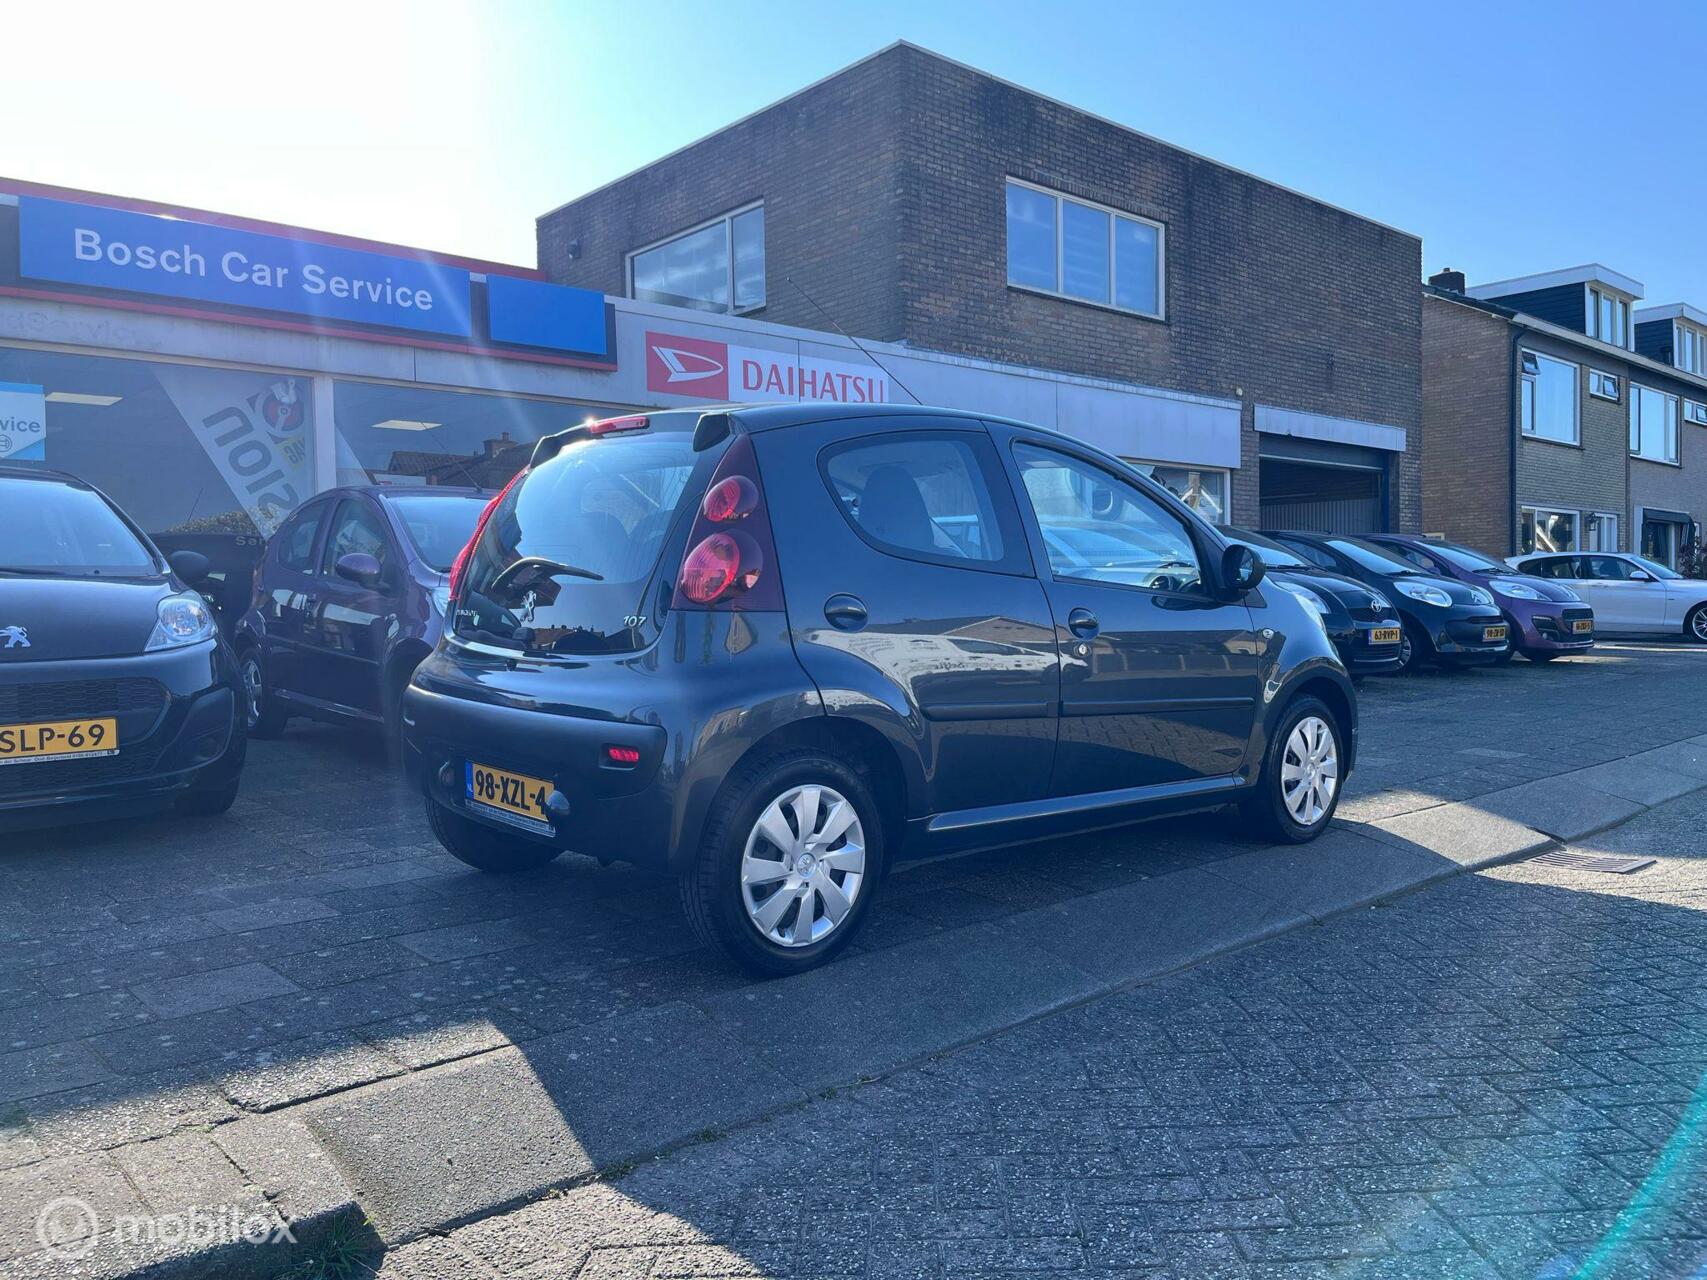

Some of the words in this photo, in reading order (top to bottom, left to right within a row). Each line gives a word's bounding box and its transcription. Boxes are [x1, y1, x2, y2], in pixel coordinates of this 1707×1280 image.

[74, 227, 206, 277] Bosch
[221, 250, 289, 288] Car
[301, 263, 434, 311] Service
[742, 359, 884, 403] DAIHATSU
[623, 615, 647, 627] 107
[0, 723, 105, 753] SLP-69
[475, 769, 546, 815] 98-XZL-4
